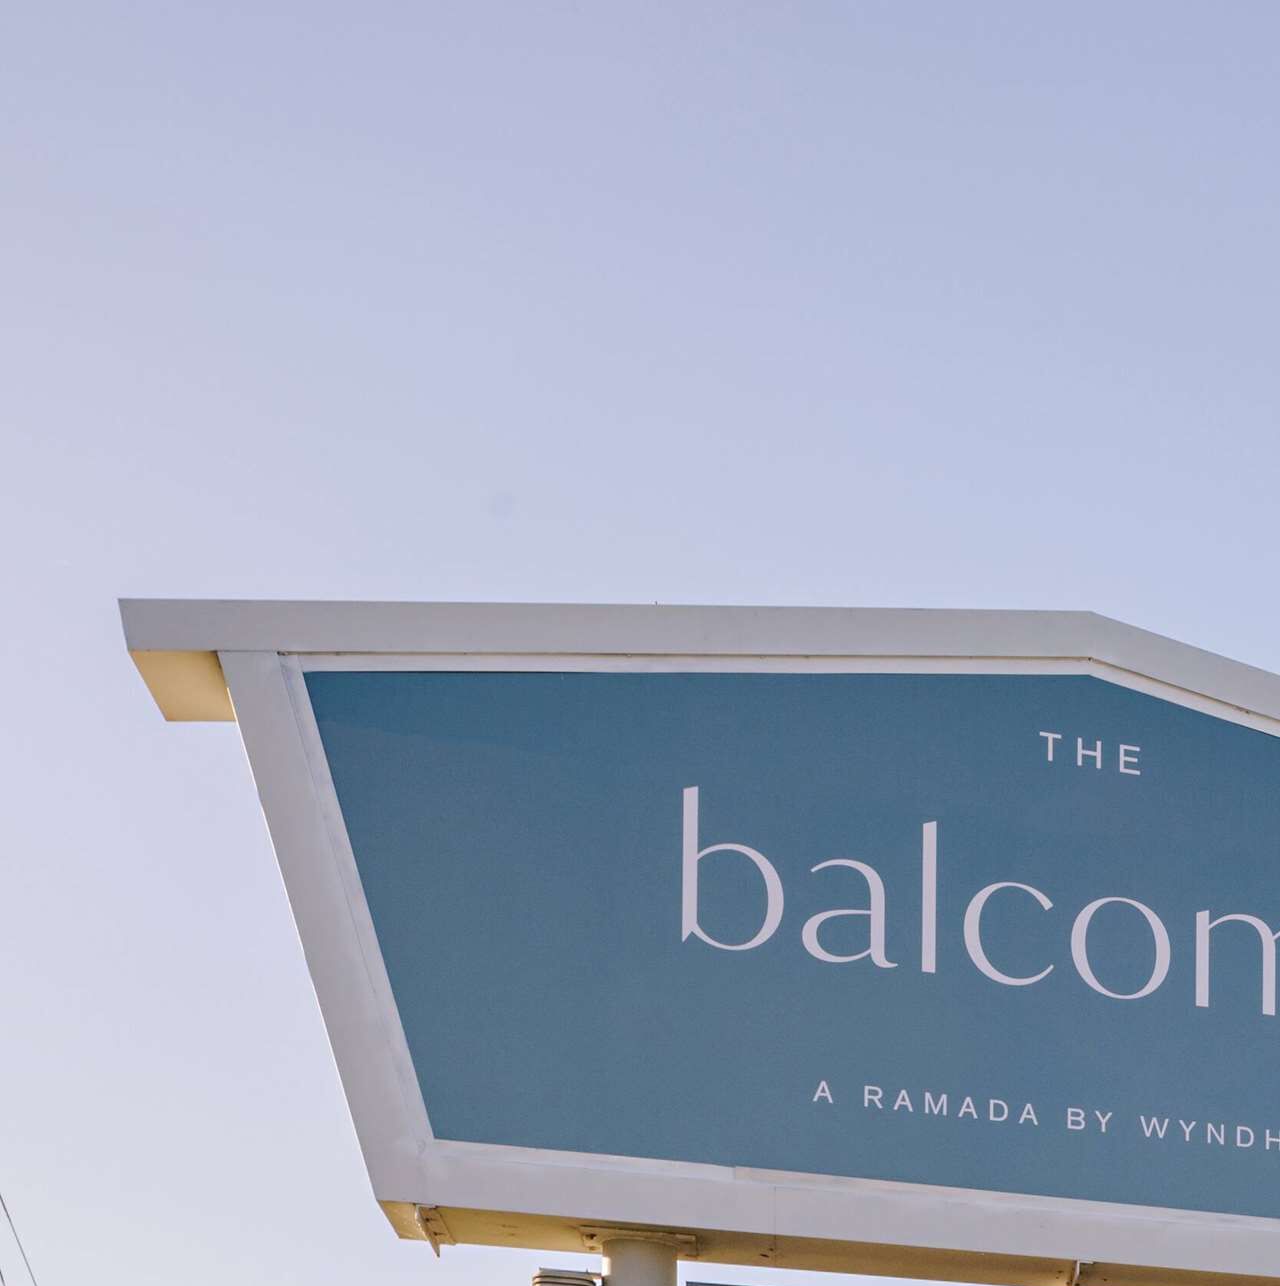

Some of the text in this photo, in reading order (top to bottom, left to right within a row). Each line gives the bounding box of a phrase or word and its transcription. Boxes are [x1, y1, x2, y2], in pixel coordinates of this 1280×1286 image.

[1039, 731, 1141, 776] THE
[812, 1080, 833, 1104] A
[863, 1085, 1039, 1126] RAMADA
[1067, 1107, 1113, 1133] BY
